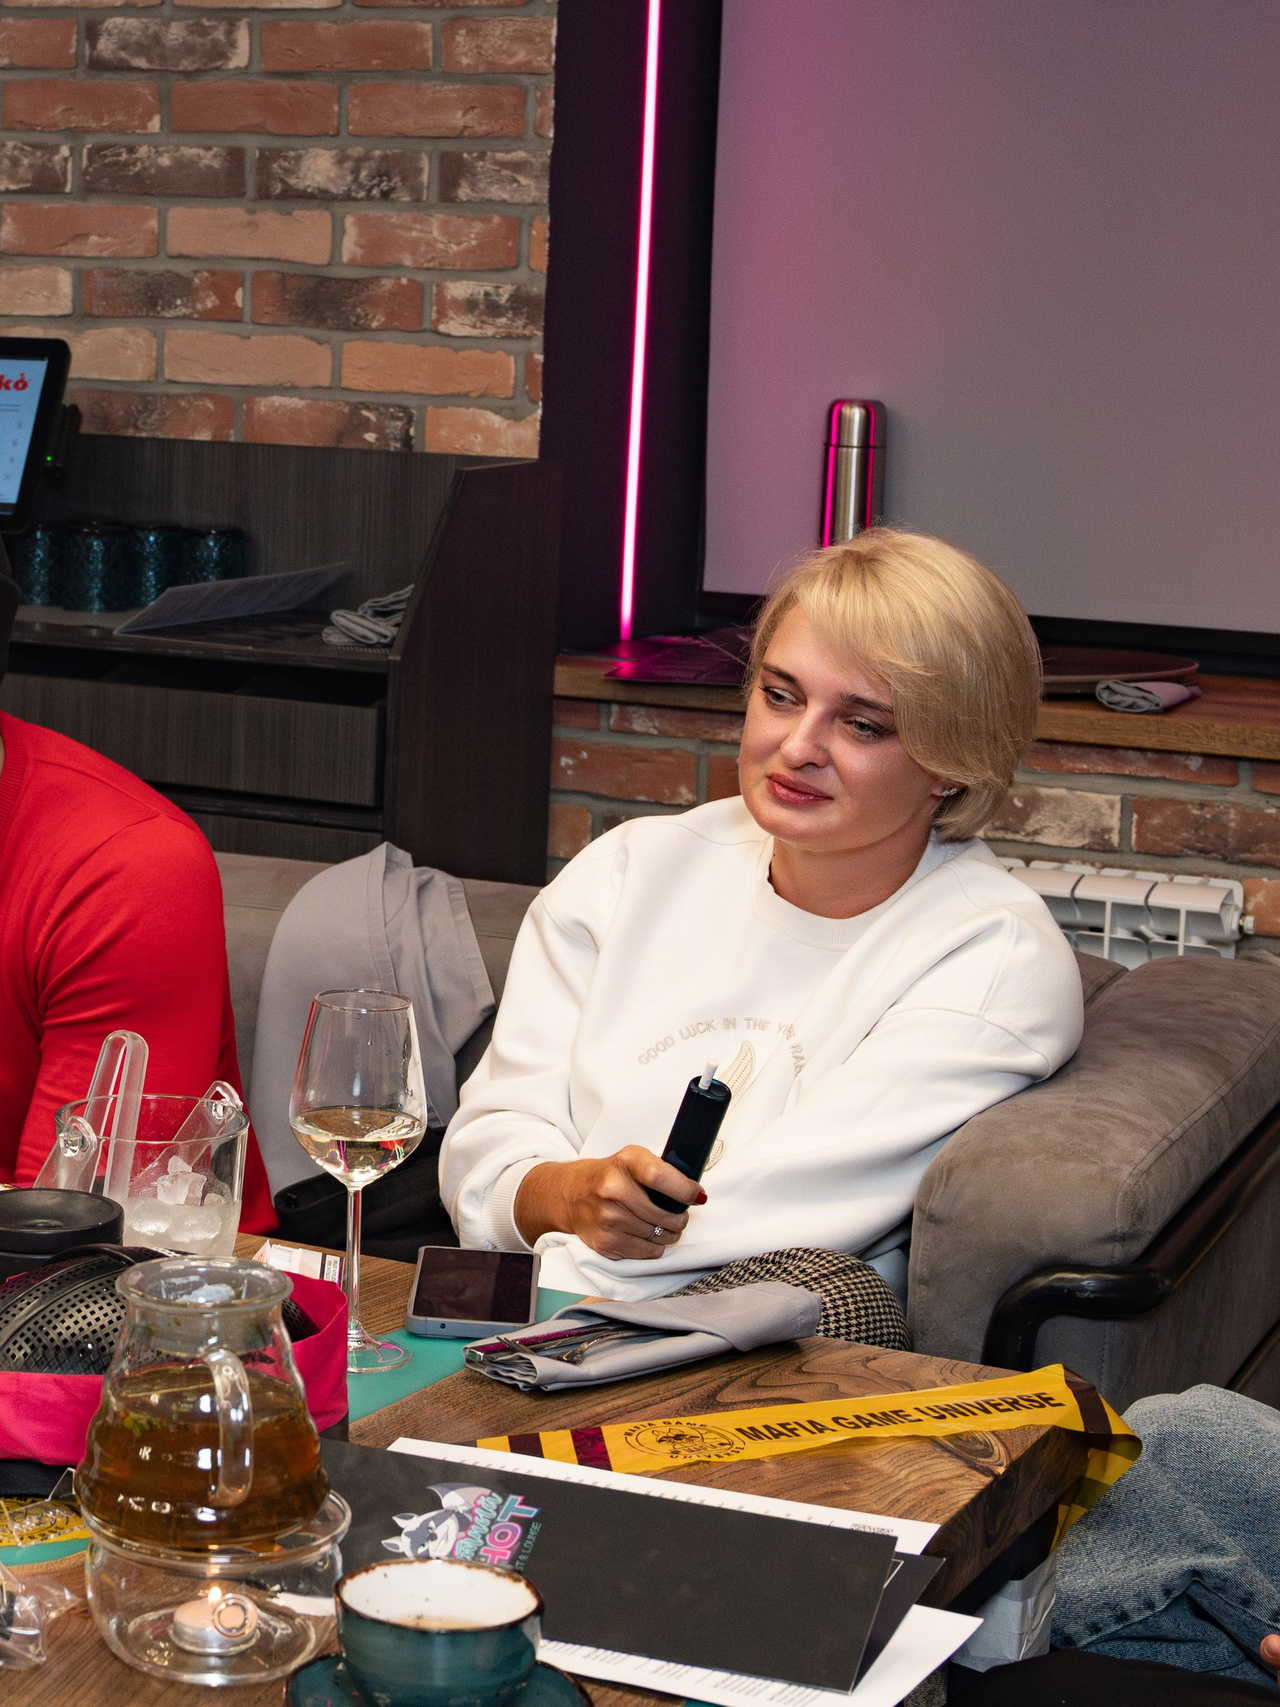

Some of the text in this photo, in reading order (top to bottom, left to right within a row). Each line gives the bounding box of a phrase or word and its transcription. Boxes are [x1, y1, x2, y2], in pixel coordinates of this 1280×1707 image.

[637, 1035, 676, 1065] GOOD
[678, 1018, 718, 1040] LUCK
[723, 1017, 737, 1030] IN
[744, 1017, 771, 1031] THE
[734, 1392, 1066, 1441] MAFIA GAME UNIVERSE
